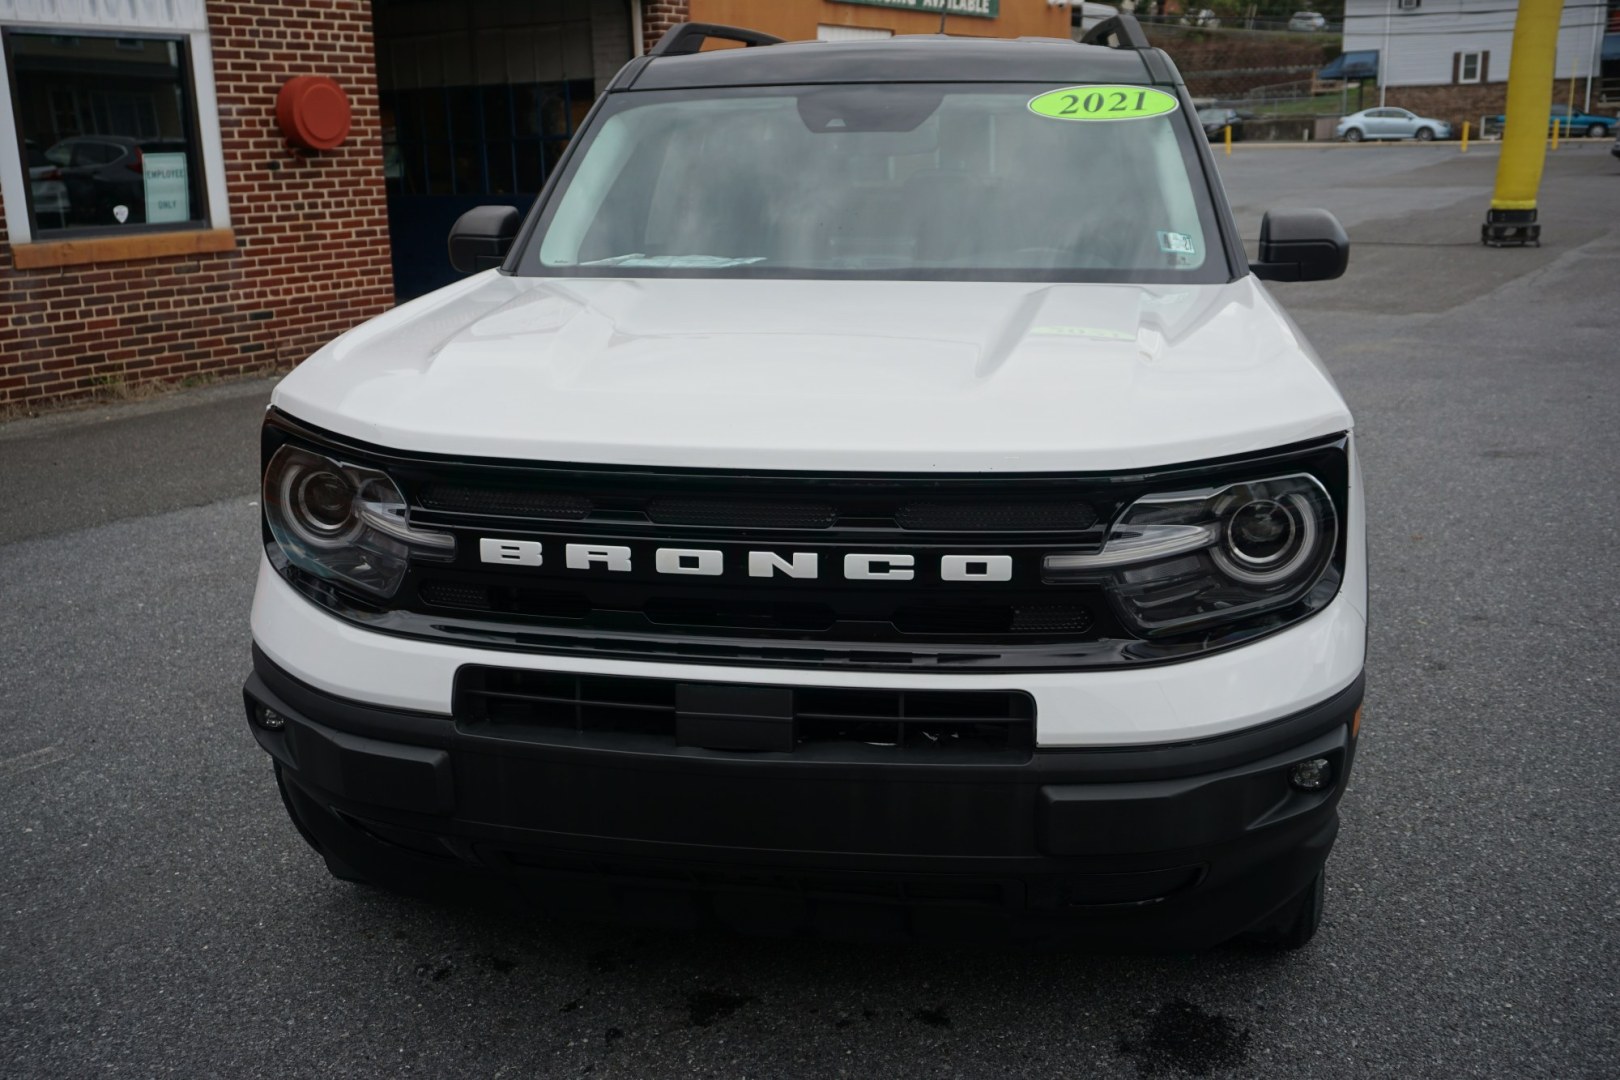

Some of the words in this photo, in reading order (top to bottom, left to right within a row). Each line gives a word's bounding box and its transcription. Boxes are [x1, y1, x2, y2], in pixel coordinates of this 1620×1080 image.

[1058, 91, 1147, 115] 2021
[146, 169, 185, 179] EMPLOYEE
[158, 200, 177, 210] ONLY
[479, 537, 1013, 582] BRONCO
